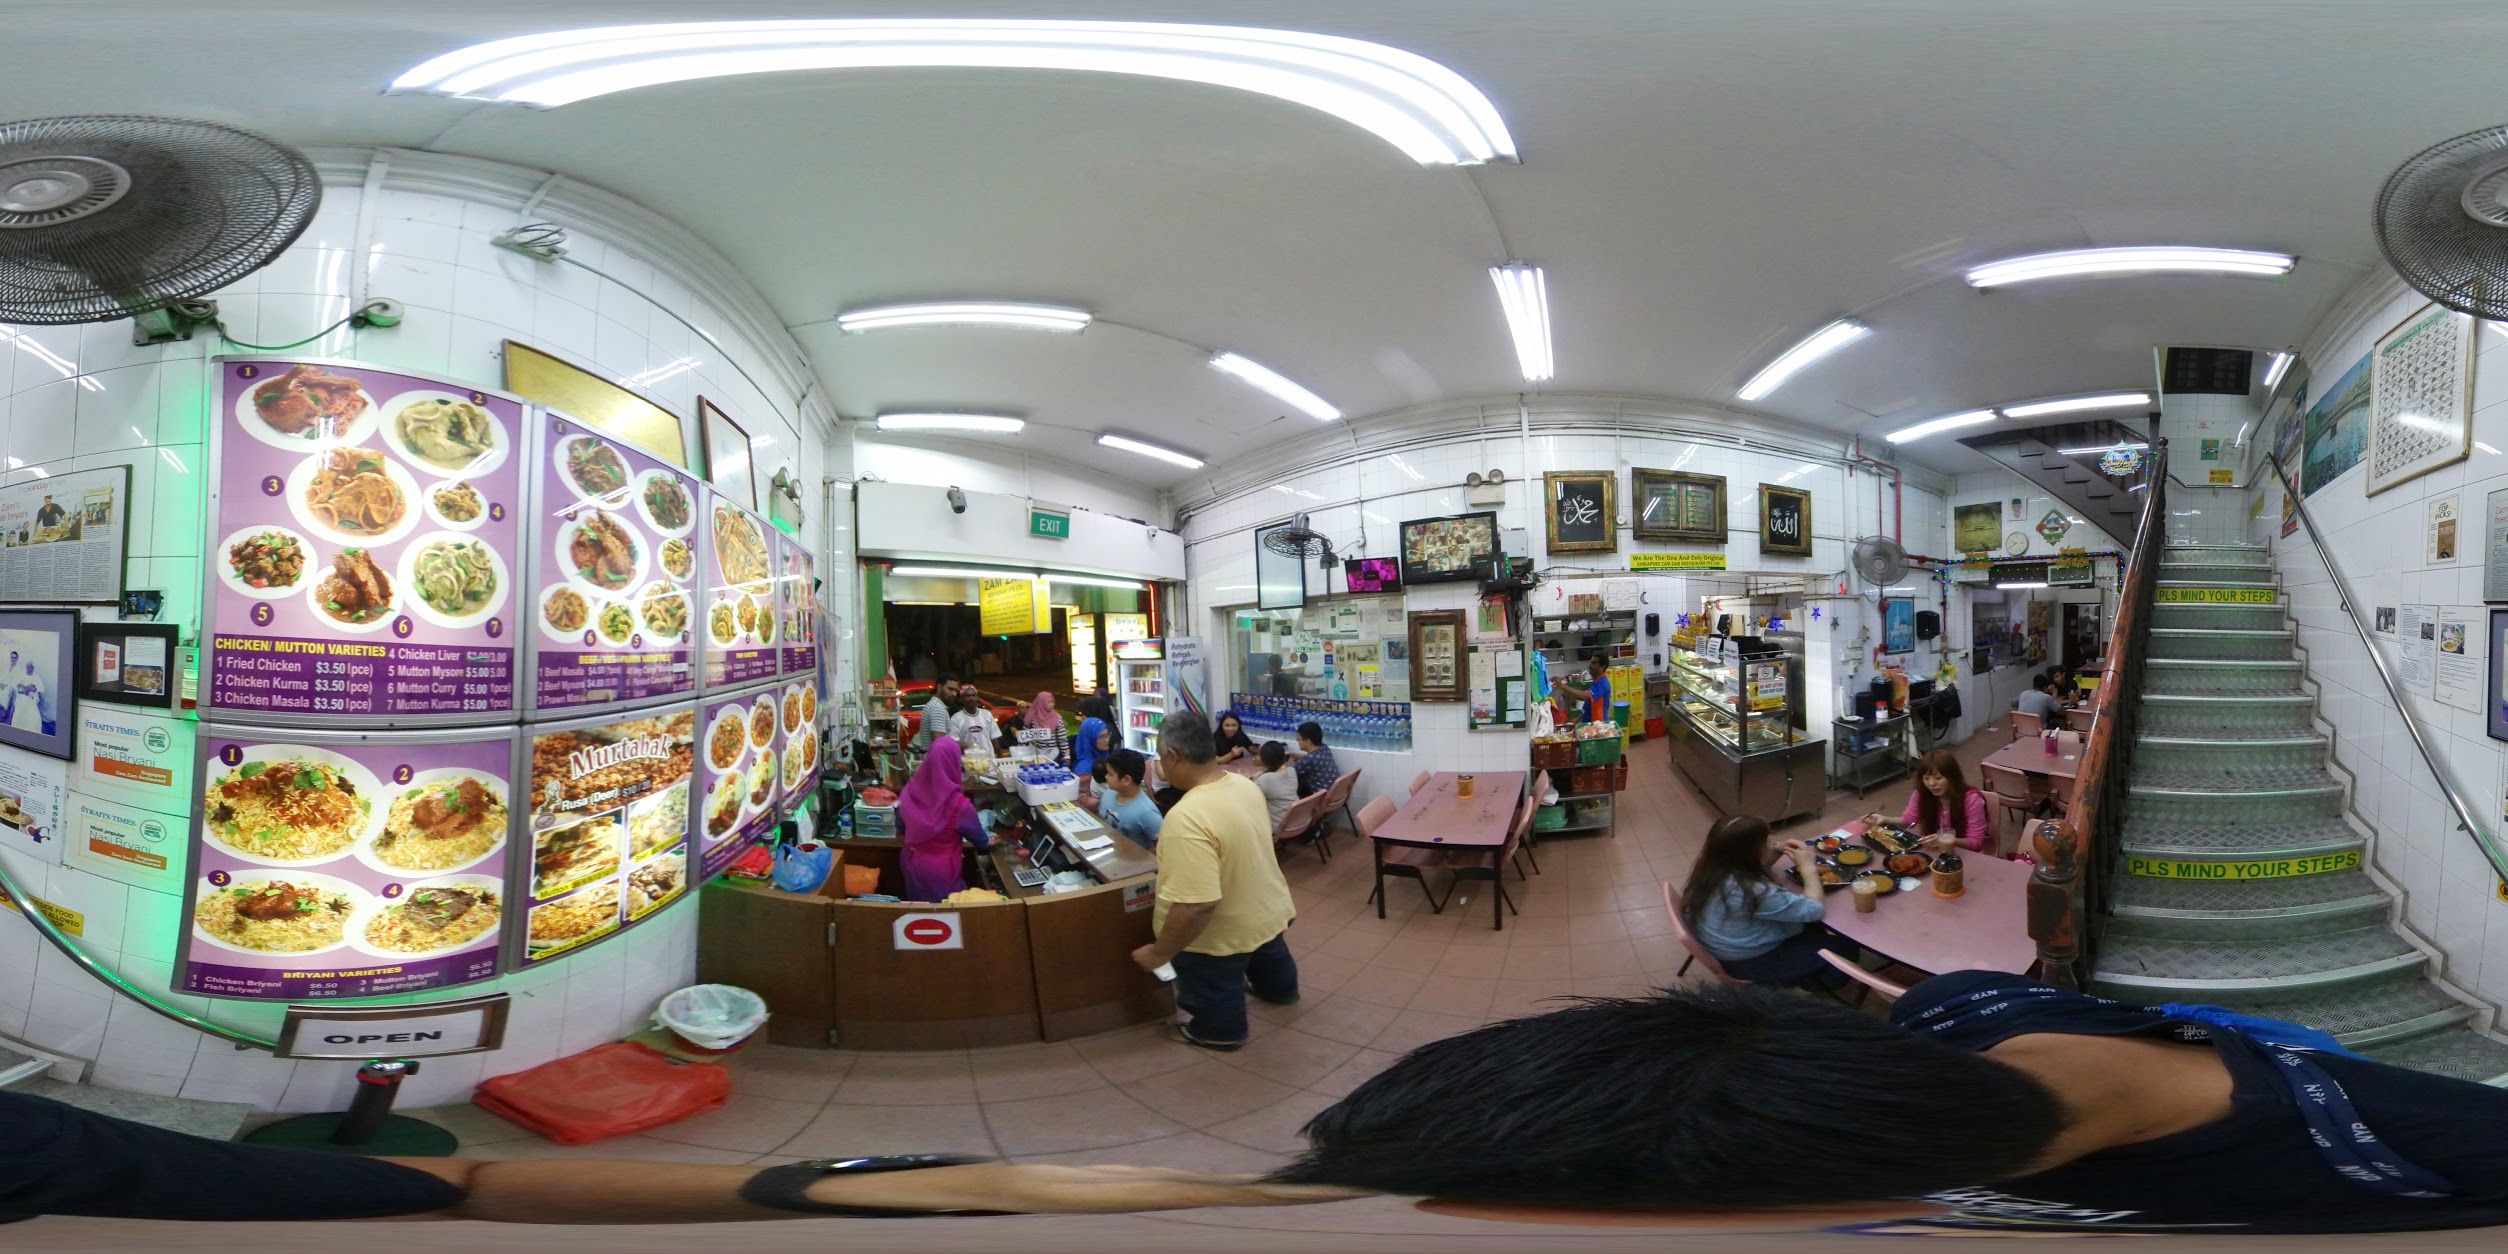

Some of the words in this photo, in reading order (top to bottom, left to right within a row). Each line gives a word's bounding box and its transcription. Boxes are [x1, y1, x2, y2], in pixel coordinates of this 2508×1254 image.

[244, 367, 251, 376] 1
[474, 394, 483, 404] 2
[268, 479, 278, 492] 3
[492, 507, 501, 518] 4
[2438, 504, 2449, 513] TOP
[1040, 518, 1060, 533] EXIT
[2159, 590, 2178, 601] PLS
[2180, 590, 2205, 601] MIND
[2208, 590, 2237, 601] YOUR
[2239, 591, 2272, 602] STEPS
[257, 606, 268, 621] 5
[398, 621, 408, 634] 6
[490, 621, 498, 634] 7
[586, 632, 594, 644] 6
[215, 637, 272, 651] CHICKEN/
[275, 641, 325, 654] MUTTON
[329, 644, 386, 657] VARIETIES
[388, 648, 395, 659] 4
[398, 648, 436, 661] Chicken
[438, 649, 461, 661] Liver
[217, 656, 223, 668] 1
[226, 656, 254, 670] Fried
[257, 658, 301, 672] Chicken
[316, 661, 346, 674] $3.50
[388, 665, 395, 676] 5
[397, 665, 430, 677] Mutton
[432, 666, 465, 679] Mysore
[465, 667, 489, 678] $5.00
[215, 674, 223, 686] 2
[225, 675, 270, 688] Chicken
[273, 677, 309, 690] Kurma
[315, 679, 344, 692] $3.50
[387, 682, 394, 693] 6
[396, 682, 430, 694] Mutton
[431, 682, 457, 695] Curry
[464, 683, 488, 695] $5.00
[215, 692, 222, 703] 3
[224, 692, 269, 706] Chicken
[272, 695, 310, 708] Masala
[314, 698, 344, 711] $3.50
[387, 699, 394, 710] 7
[396, 699, 429, 710] Mutton
[431, 699, 461, 710] Kurma
[463, 699, 488, 710] $5.00
[84, 719, 114, 732] STRAITS
[1020, 729, 1048, 740] CASHIER
[94, 740, 108, 749] Most
[108, 744, 130, 752] popular
[94, 747, 117, 760] Nasi
[119, 753, 156, 768] Bryani
[228, 748, 236, 761] 1
[569, 732, 673, 781] Murtabak
[399, 767, 409, 781] 2
[562, 797, 588, 812] Rusa
[590, 787, 619, 805] (Deer)
[80, 806, 111, 820] STRAITS
[90, 824, 103, 832] Most
[104, 828, 126, 838] popular
[89, 829, 114, 843] Nasi
[115, 837, 151, 854] Bryani
[2132, 859, 2169, 876] PLS
[2176, 863, 2227, 878] MIND
[2233, 861, 2290, 878] YOUR
[2296, 852, 2358, 874] STEPS
[215, 872, 225, 885] 3
[388, 885, 399, 896] 4
[540, 885, 569, 898] Mutton
[56, 908, 74, 919] FOOD
[338, 966, 402, 977] VARIETIES
[373, 976, 406, 985] Mutton
[407, 971, 439, 981] Briyani
[203, 983, 225, 991] Fish
[226, 985, 262, 994] Briyani
[205, 976, 245, 986] Chicken
[246, 980, 282, 989] Briyani
[372, 984, 395, 992] Beef
[395, 980, 428, 989] Briyani
[1970, 989, 1998, 1001] NYP
[1921, 1006, 1945, 1018] NYP
[1979, 1002, 2008, 1016] NYP
[1932, 1020, 1955, 1031] NYP
[323, 1030, 443, 1045] OPEN
[2351, 1122, 2377, 1143] NYP
